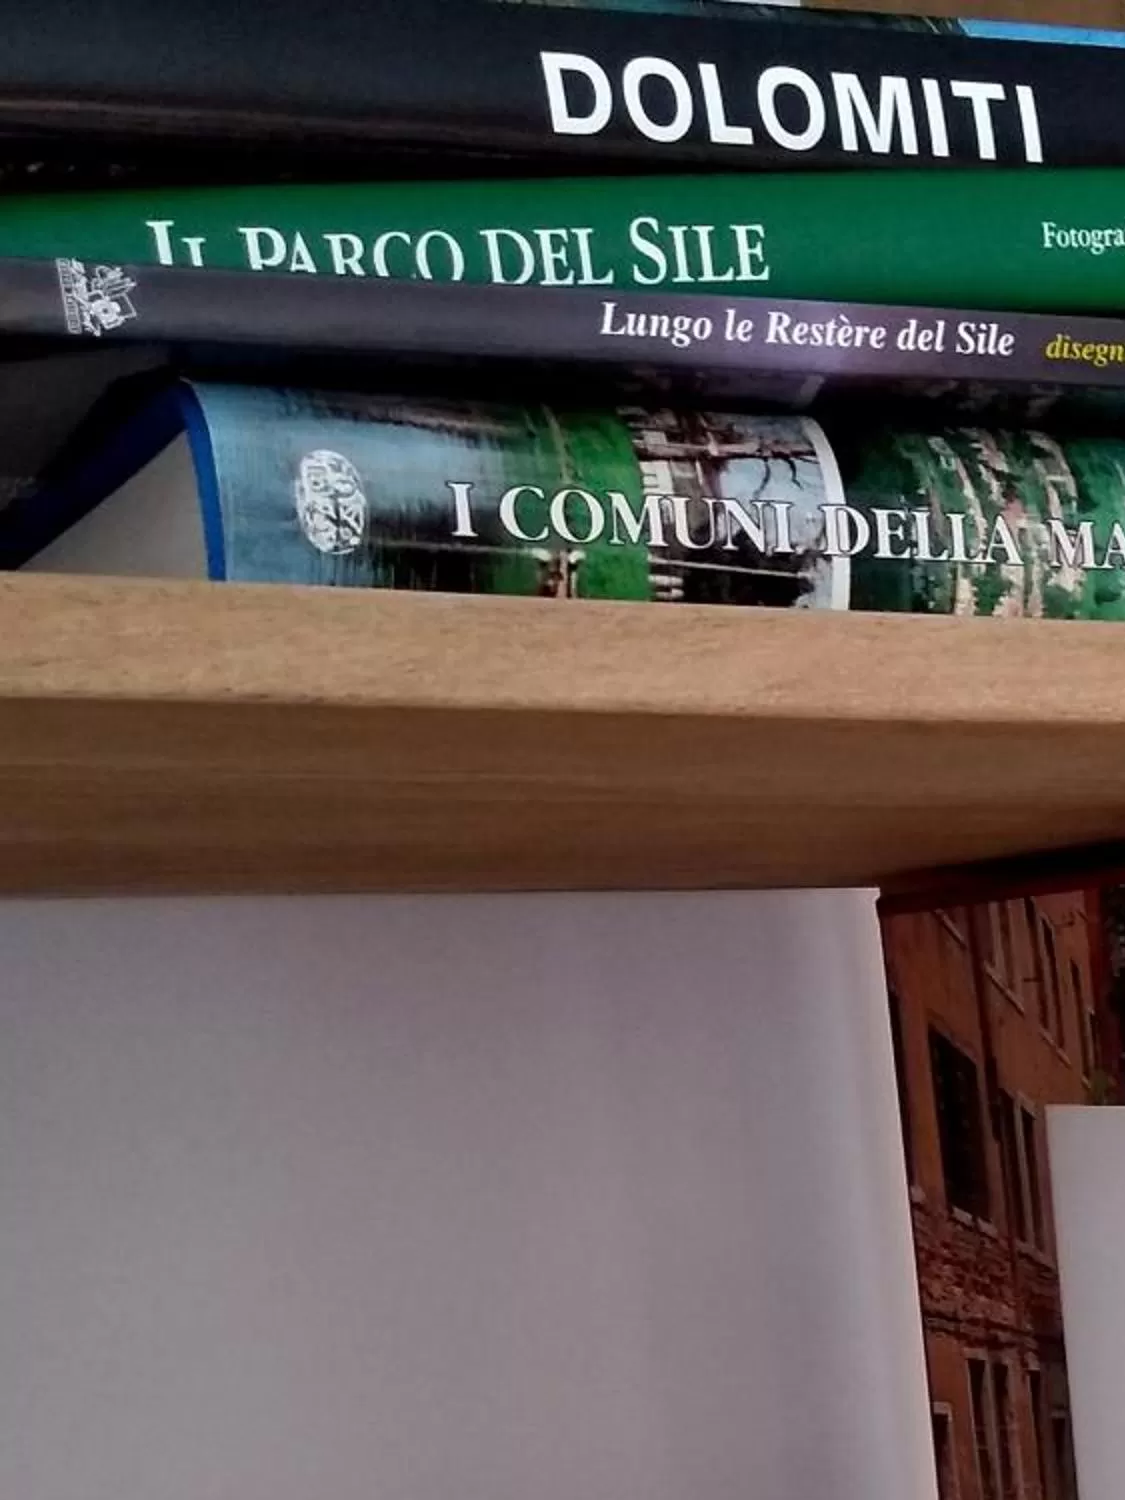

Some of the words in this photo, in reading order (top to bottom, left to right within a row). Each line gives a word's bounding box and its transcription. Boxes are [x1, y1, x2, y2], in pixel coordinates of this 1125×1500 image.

[540, 51, 1043, 162] DOLOMITI
[237, 226, 464, 281] PARCO
[479, 227, 614, 285] DEL
[628, 217, 770, 285] SILE
[600, 301, 713, 348] Lungo
[724, 309, 753, 342] le
[766, 310, 887, 349] Restère
[896, 319, 944, 353] del
[955, 321, 1015, 356] Sile
[447, 481, 479, 537] I
[499, 487, 794, 554] COMUNI
[819, 504, 1024, 566] DELLA
